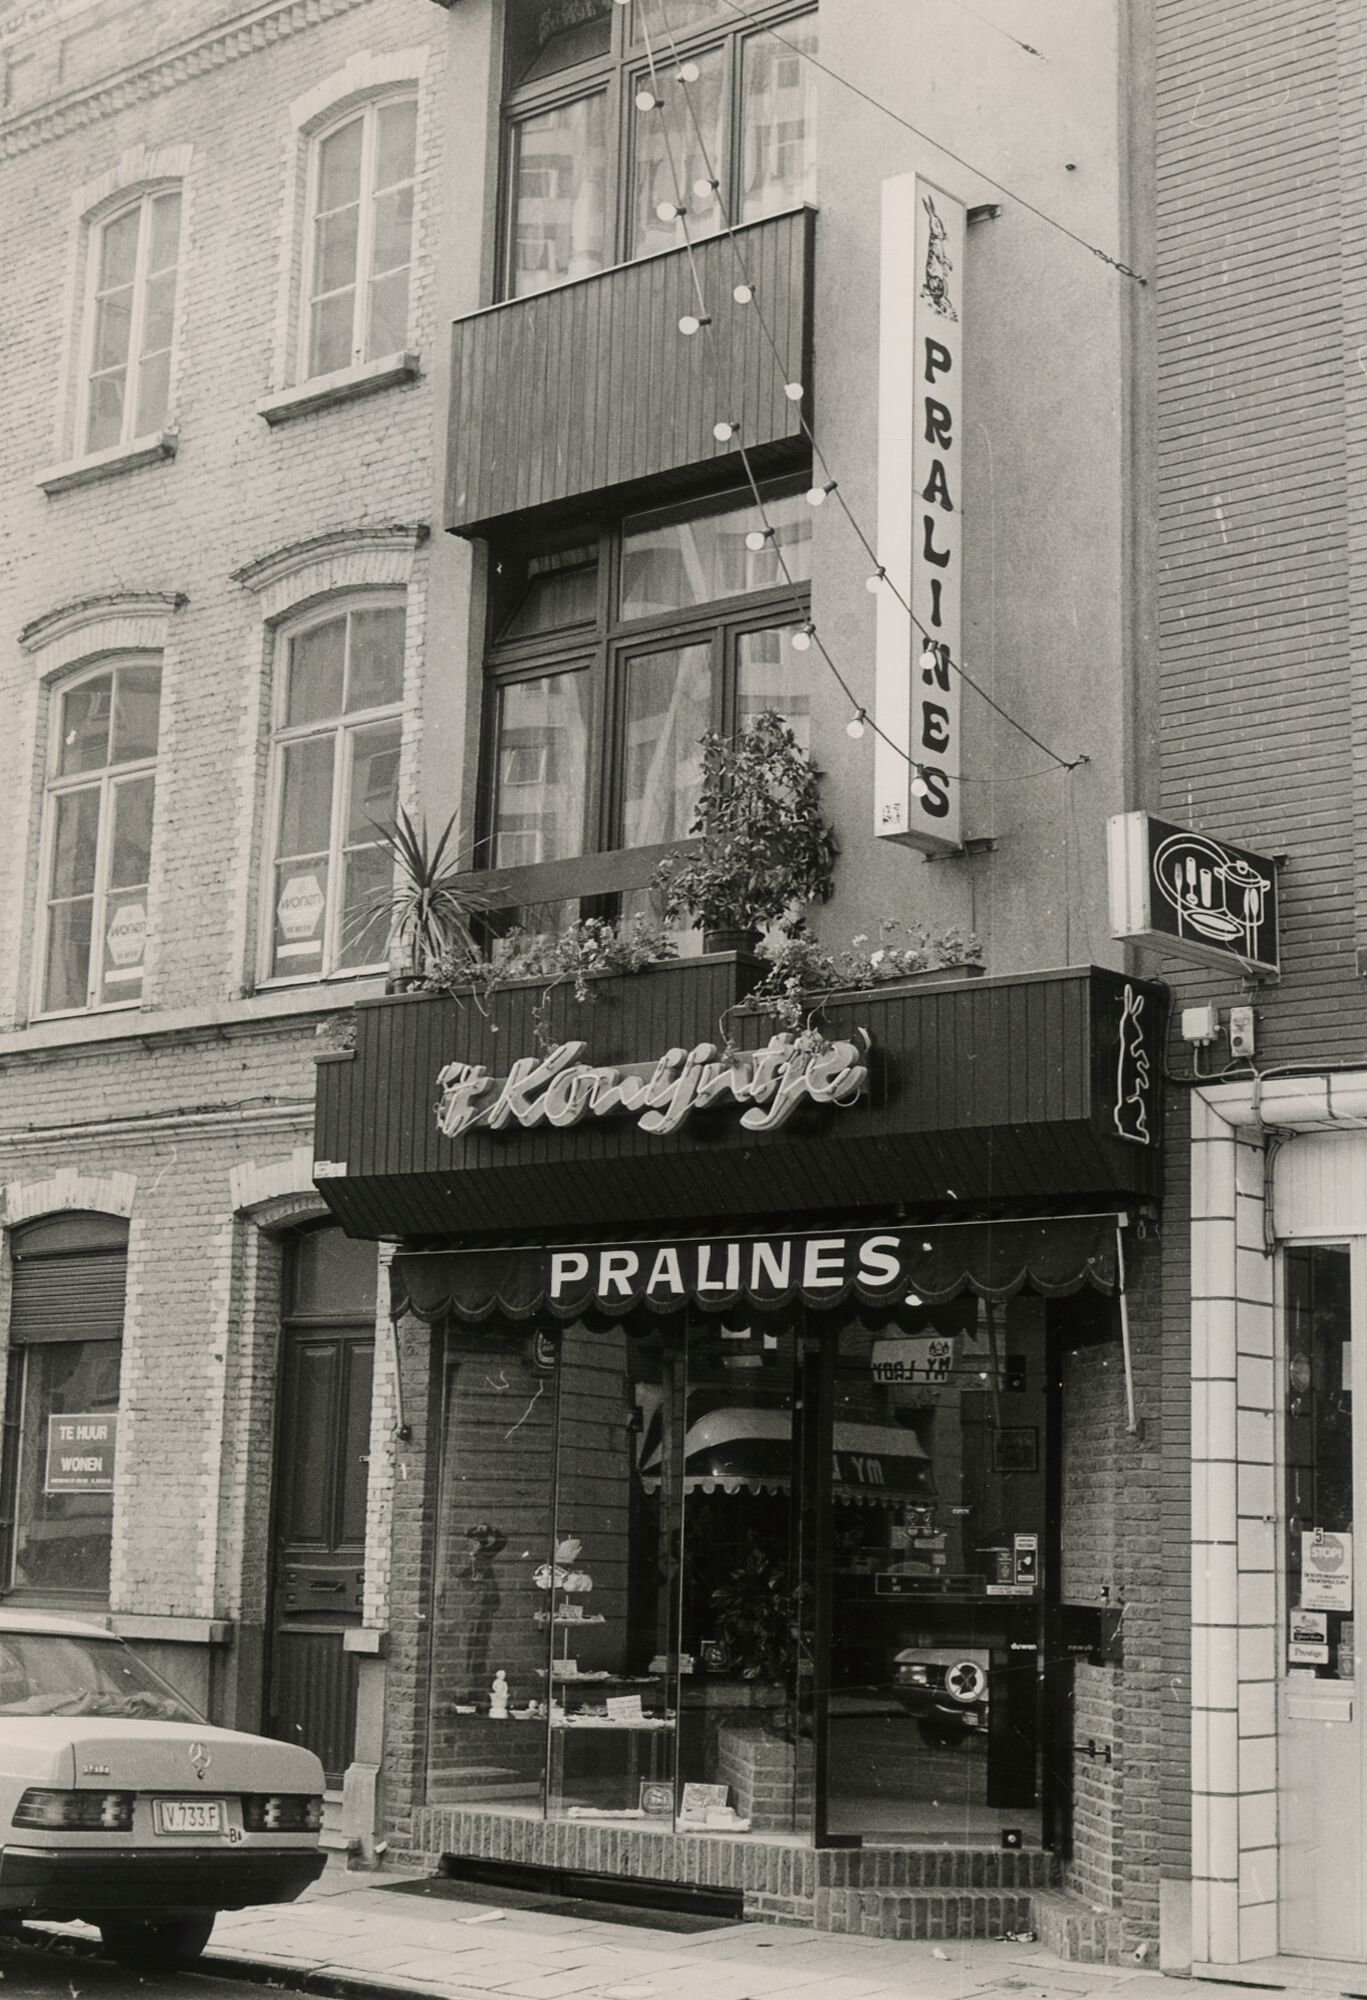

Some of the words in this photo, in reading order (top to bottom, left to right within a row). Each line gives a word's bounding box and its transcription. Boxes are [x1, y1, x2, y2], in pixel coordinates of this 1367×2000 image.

[921, 337, 953, 818] PRALINES
[487, 1032, 868, 1135] Konijntje
[550, 1236, 902, 1298] PRALINES
[59, 1426, 74, 1440] TE
[76, 1426, 108, 1440] HUUR
[61, 1457, 103, 1472] WONEN
[1315, 1528, 1322, 1543] 5
[1311, 1546, 1343, 1559] STOP!
[1010, 1641, 1038, 1650] duwen
